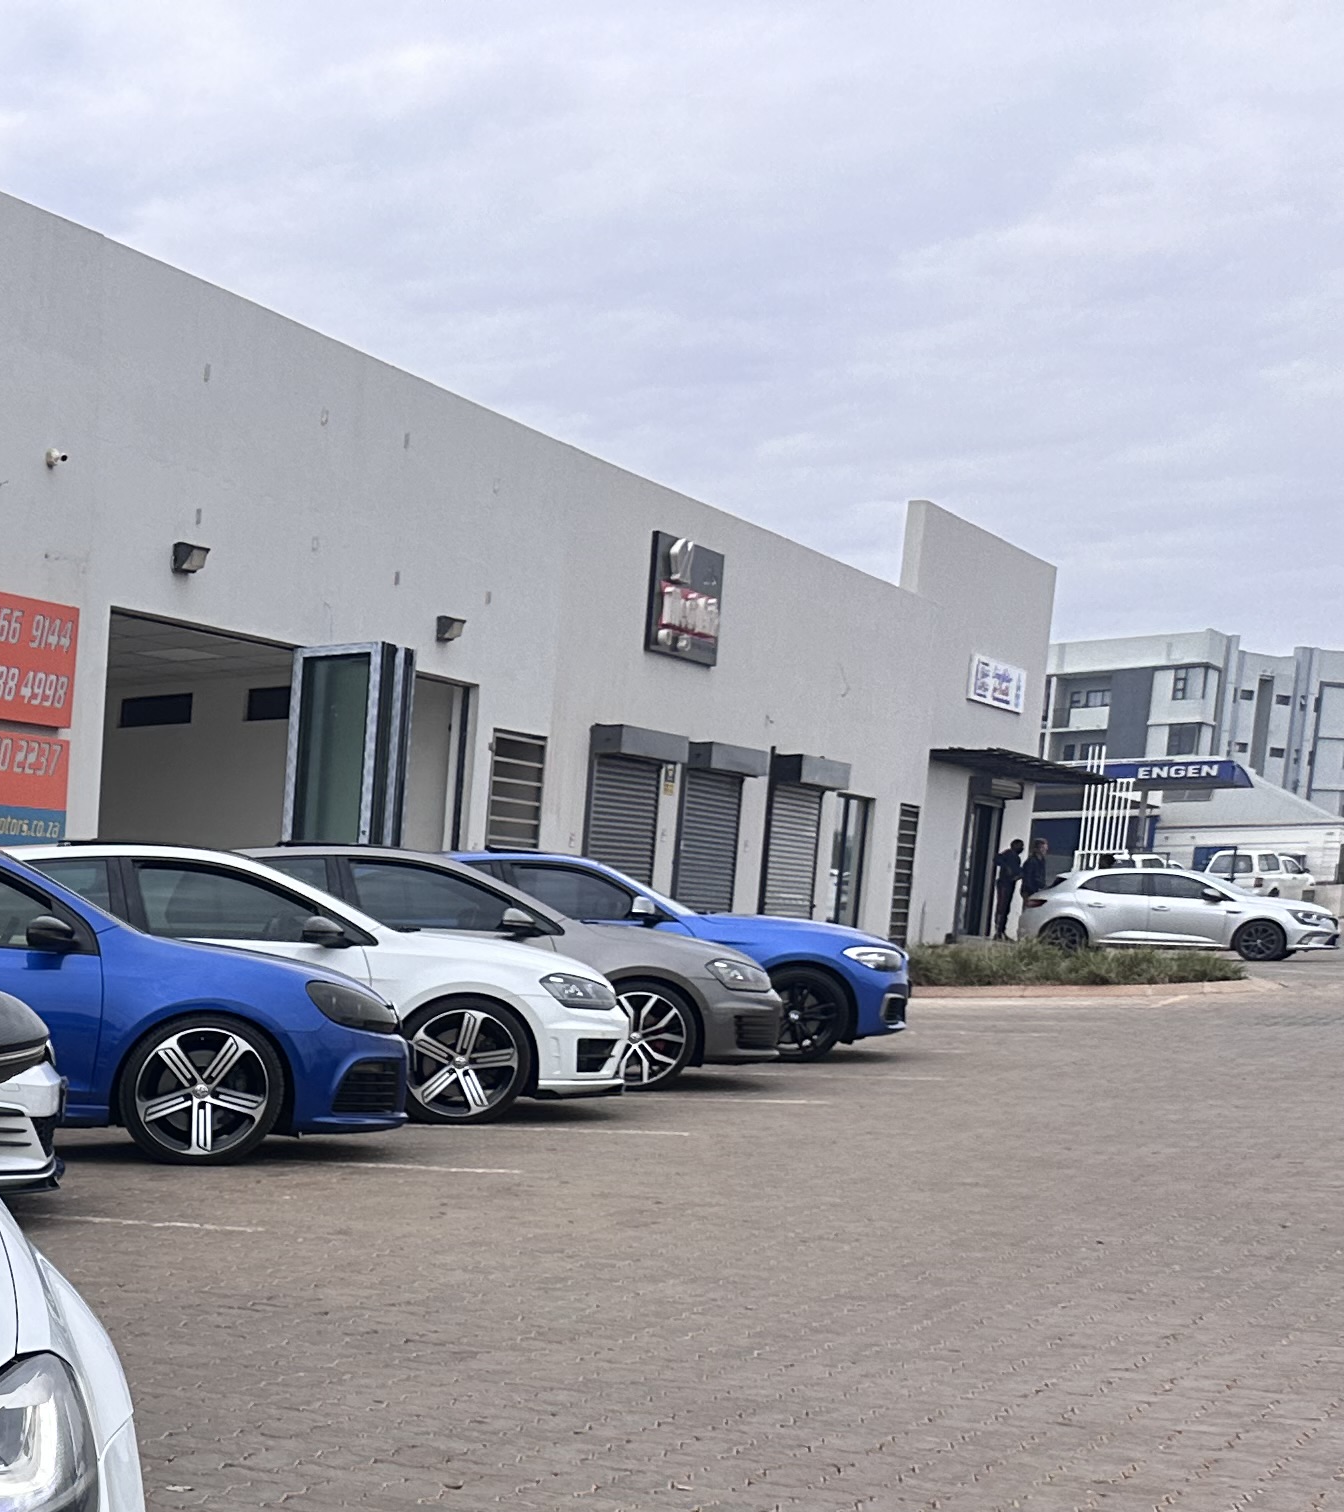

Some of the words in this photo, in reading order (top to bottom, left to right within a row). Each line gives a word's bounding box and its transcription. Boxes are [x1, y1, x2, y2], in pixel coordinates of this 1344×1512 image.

[29, 614, 73, 653] 9144
[20, 670, 69, 709] 4998
[13, 739, 62, 777] 2237
[1137, 764, 1220, 780] ENGEN
